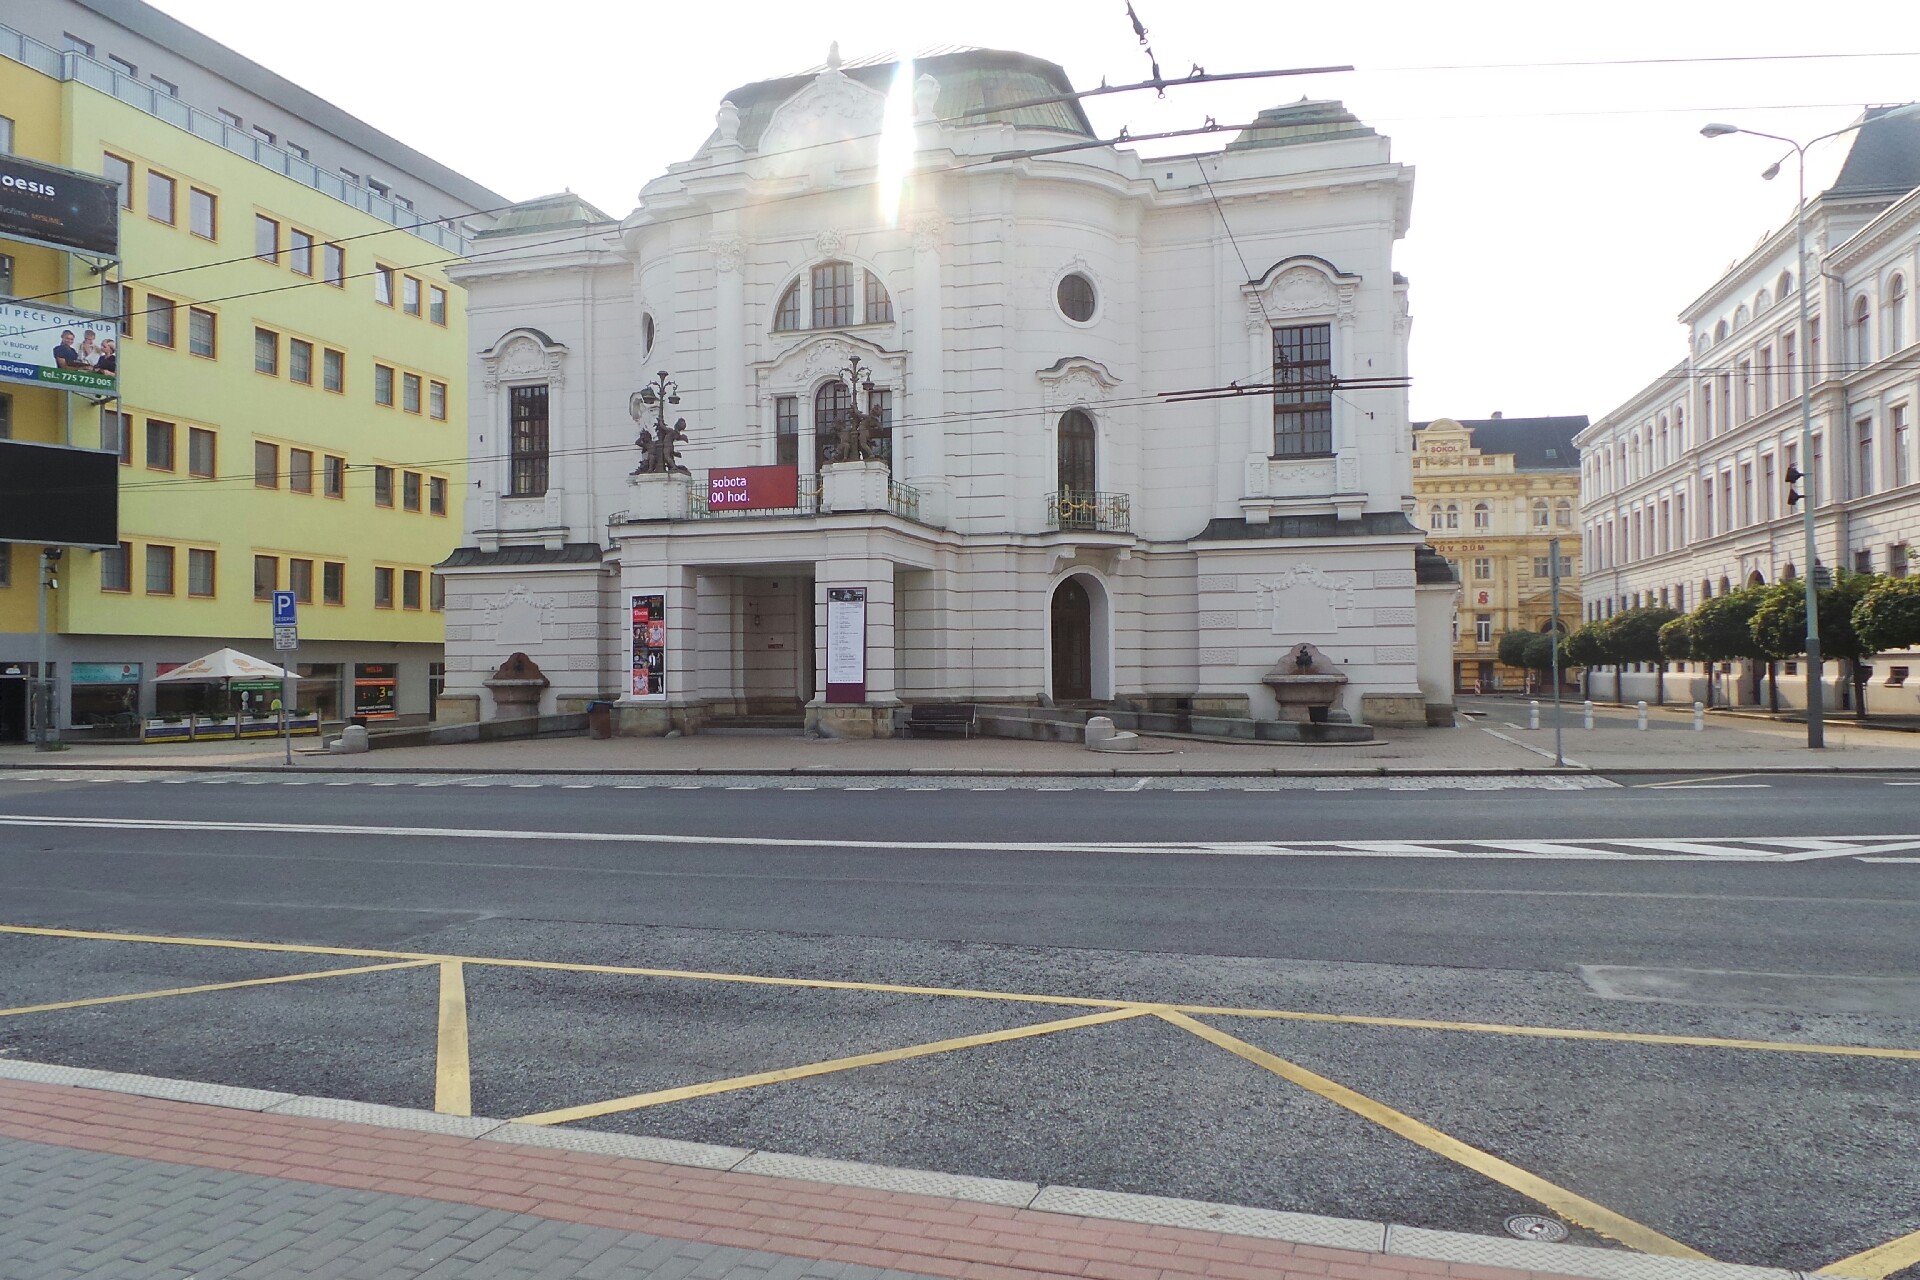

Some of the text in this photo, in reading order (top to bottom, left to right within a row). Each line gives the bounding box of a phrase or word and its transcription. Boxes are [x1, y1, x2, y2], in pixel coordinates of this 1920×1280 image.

[0, 175, 55, 196] oesis
[53, 316, 61, 324] O
[68, 319, 112, 332] CHRUP
[0, 350, 22, 359] nt.cz
[42, 370, 112, 387] tel.: 775 773 005
[712, 476, 747, 488] sobota
[727, 490, 750, 502] hod.
[277, 595, 291, 615] P
